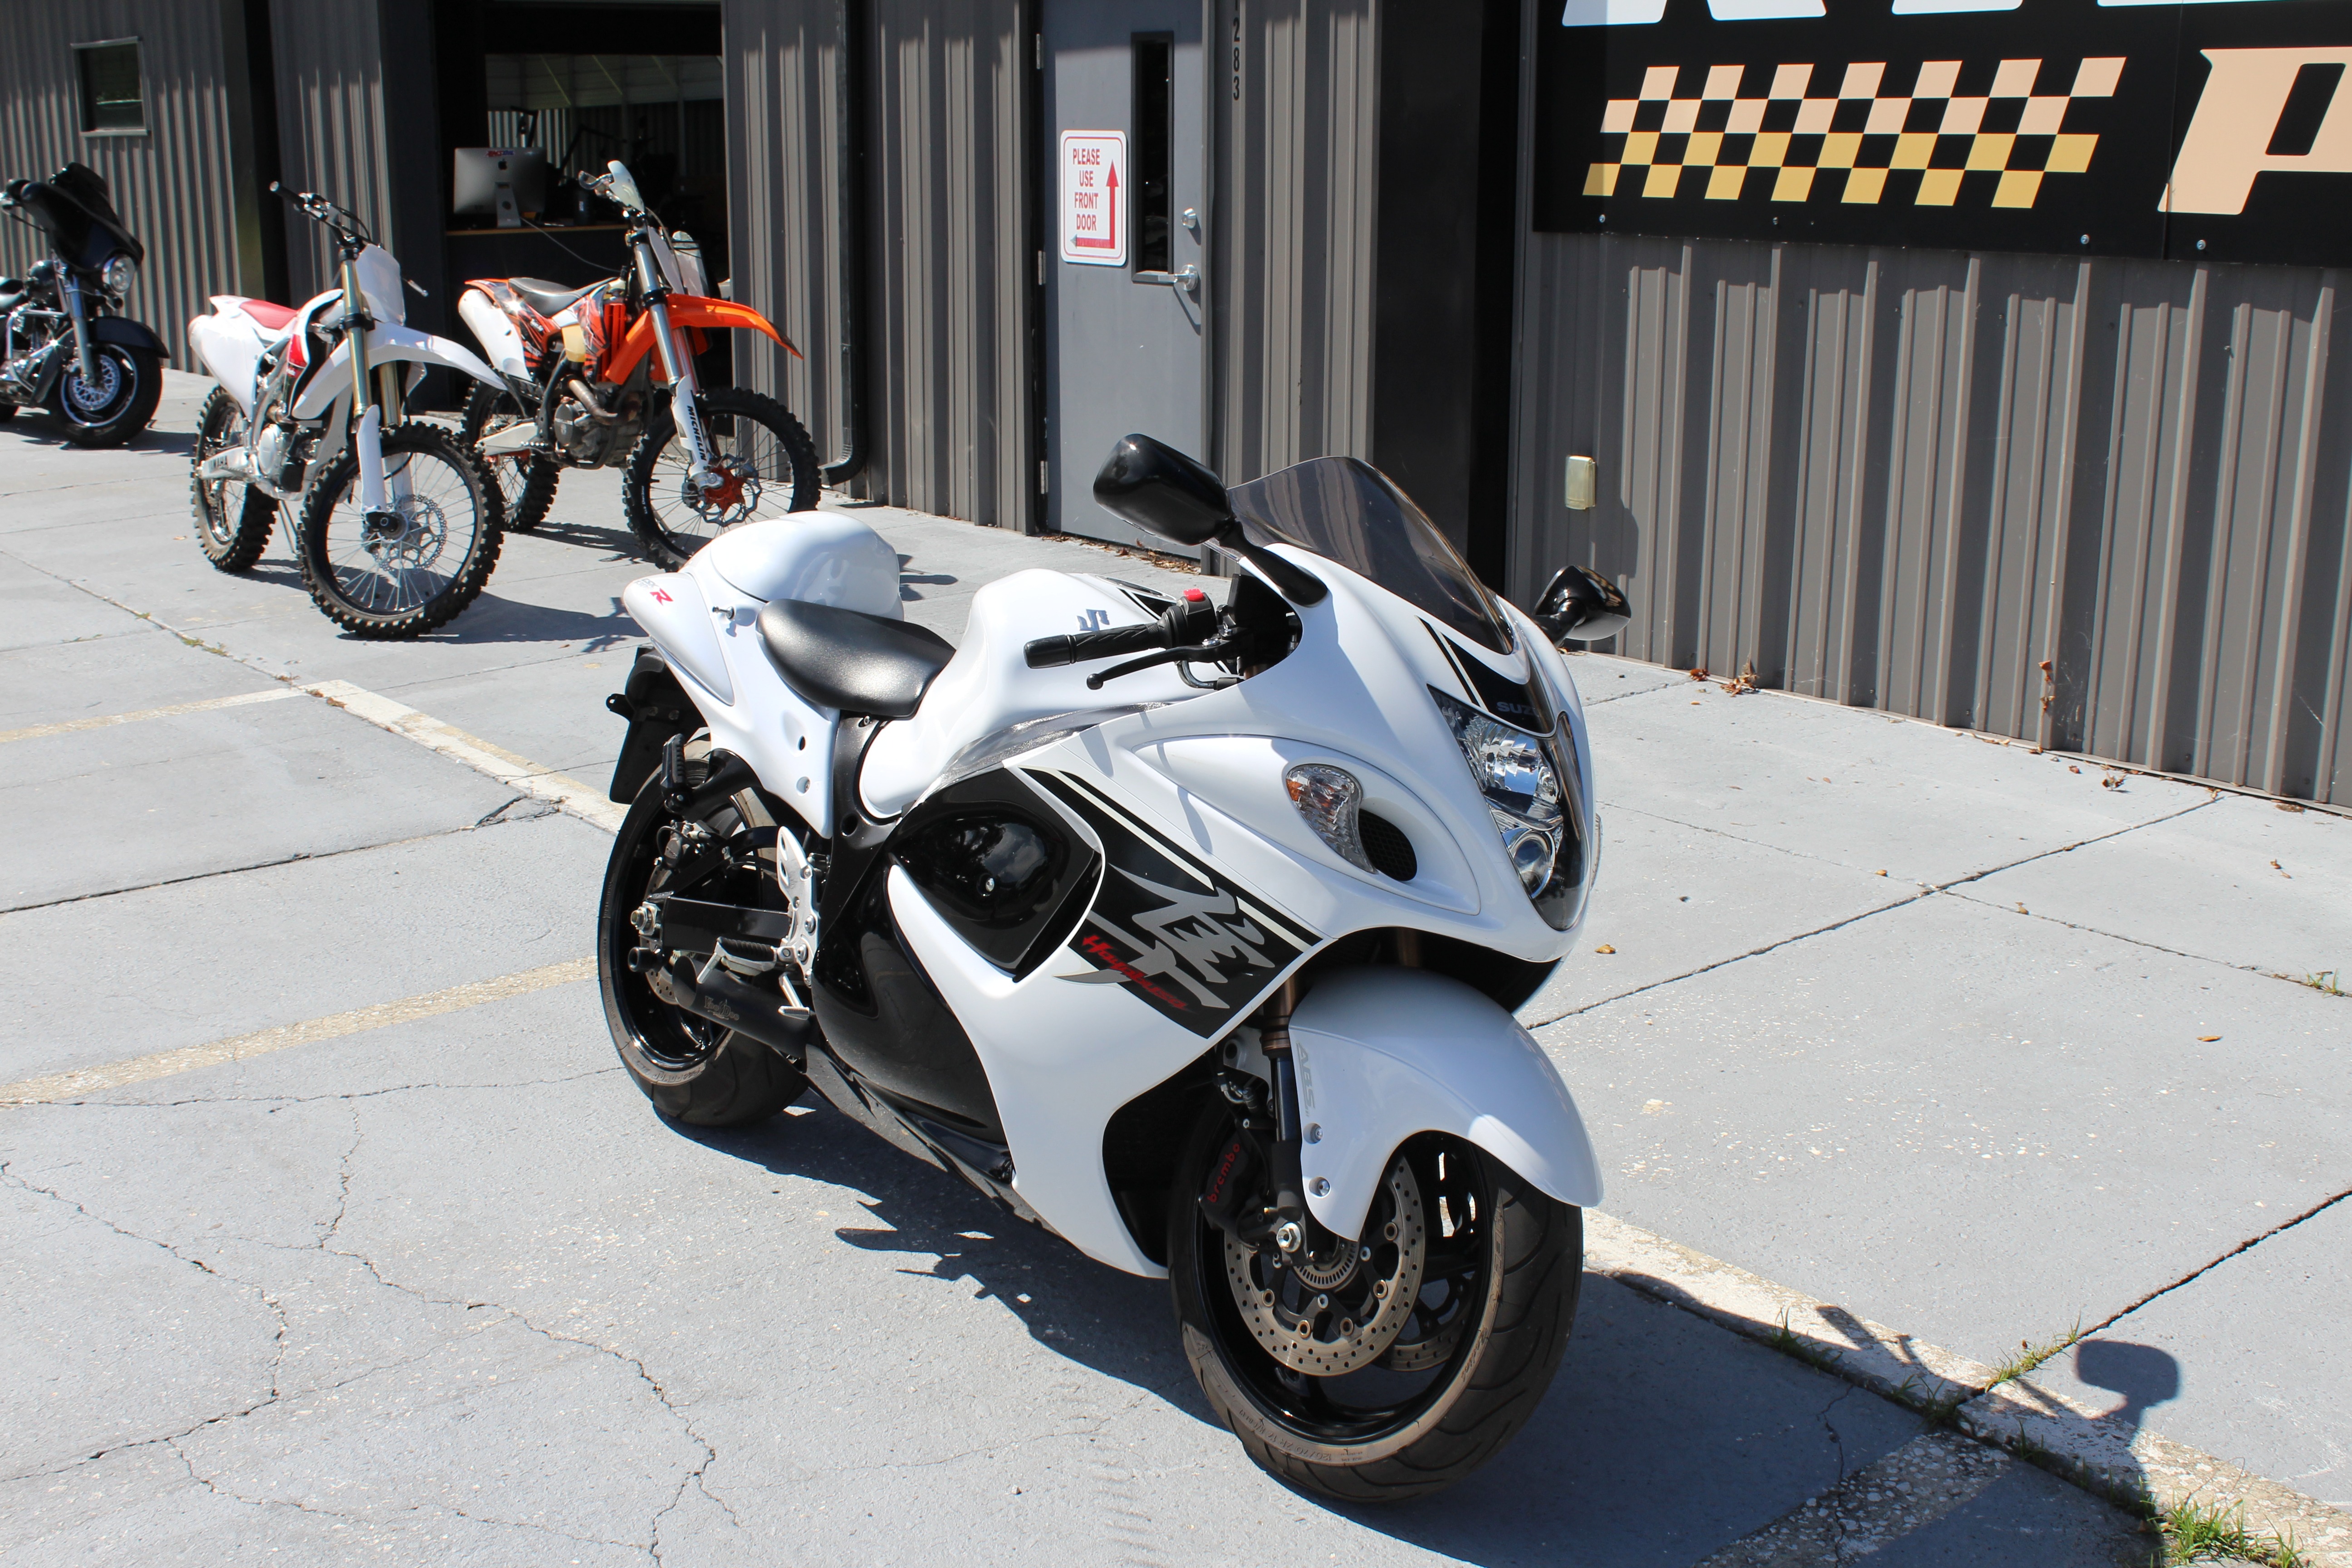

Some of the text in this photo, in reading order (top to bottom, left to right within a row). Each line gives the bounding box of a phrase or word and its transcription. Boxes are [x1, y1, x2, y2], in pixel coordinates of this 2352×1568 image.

[1073, 148, 1100, 165] PLEASE
[1079, 170, 1094, 187] USE
[1074, 192, 1098, 209] FRONT
[1076, 214, 1097, 231] DOOR
[687, 405, 707, 461] MICHELIN
[1296, 1041, 1315, 1110] ABS
[1207, 1143, 1240, 1203] brembo
[1279, 1437, 1294, 1449] ZR
[1296, 1446, 1332, 1462] 120/70
